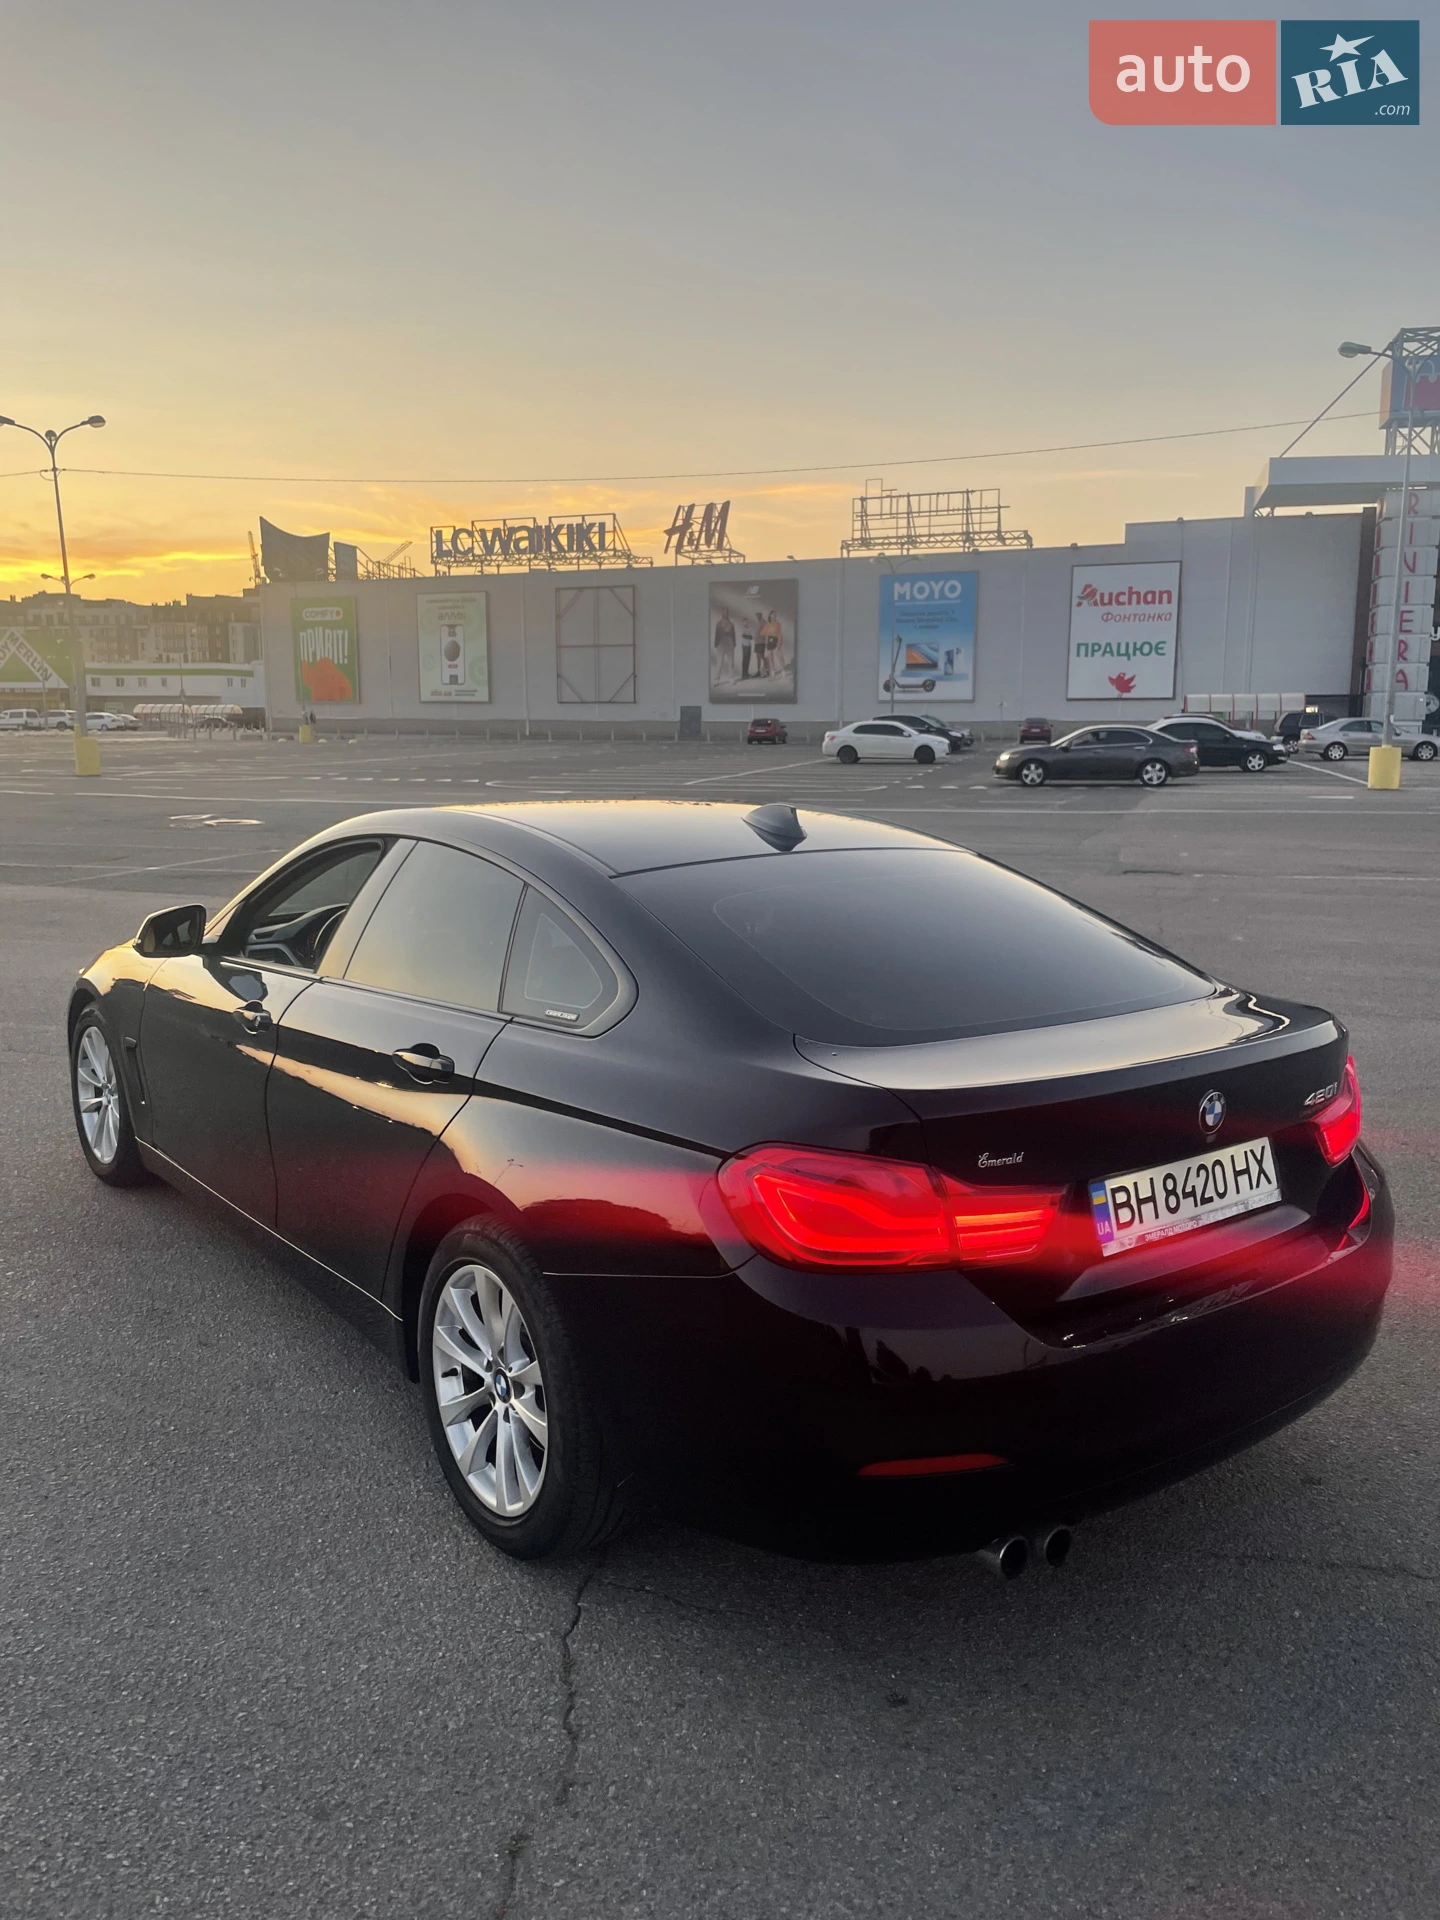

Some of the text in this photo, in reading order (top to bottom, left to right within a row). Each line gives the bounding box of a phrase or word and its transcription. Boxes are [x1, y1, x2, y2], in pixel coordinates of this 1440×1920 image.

[663, 500, 730, 554] H&M
[435, 528, 474, 557] LC
[893, 579, 962, 601] MOYO
[1076, 583, 1173, 607] Auchan
[1395, 491, 1420, 691] RIVIERA
[304, 609, 335, 619] COMFY
[1101, 611, 1173, 623] Фонтанка
[299, 627, 349, 664] ПРИВІТ!
[1076, 641, 1167, 661] ПРАЦЮЄ
[1304, 1081, 1338, 1106] 420i
[978, 1151, 1025, 1168] Emerald
[1110, 1145, 1273, 1231] BH 8420 HX
[1097, 1221, 1111, 1236] UA
